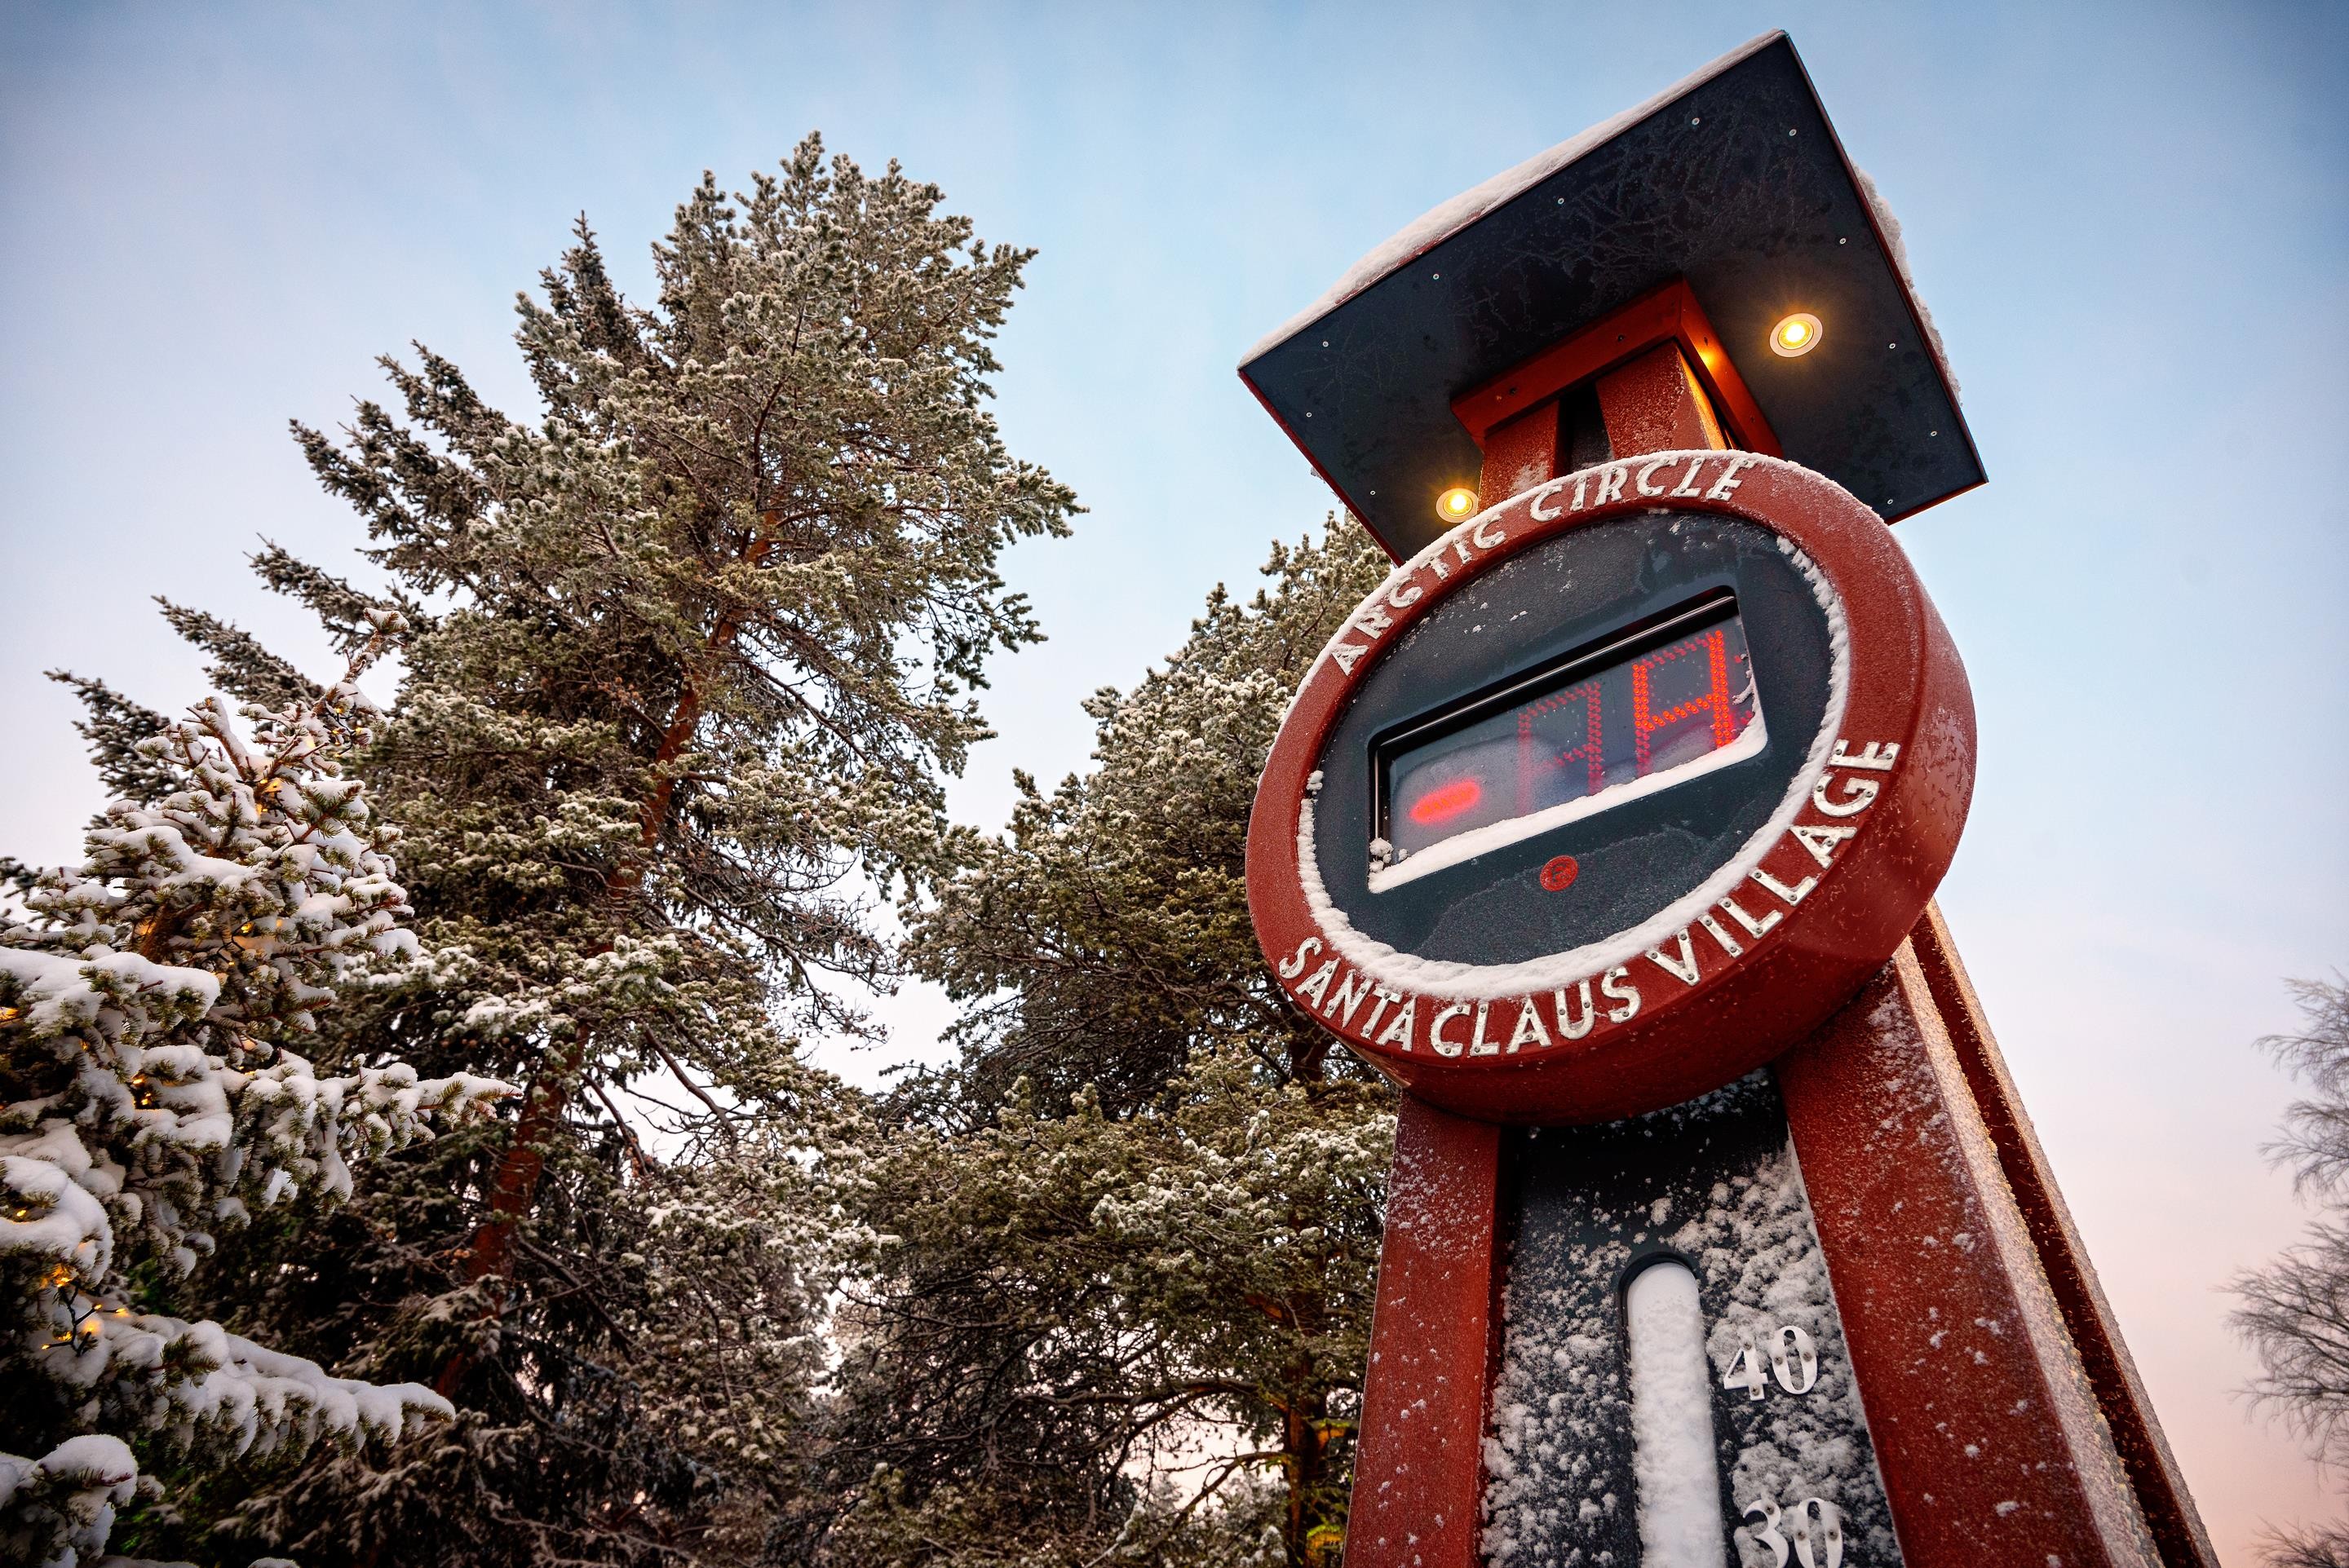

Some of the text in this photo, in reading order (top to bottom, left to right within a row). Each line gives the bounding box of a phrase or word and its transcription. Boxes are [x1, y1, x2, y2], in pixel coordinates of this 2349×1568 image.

[1329, 457, 1757, 676] ARCTIC CIRCLE
[1278, 739, 1901, 1058] SANTA CLAUS VILLAGE
[1723, 1325, 1818, 1401] 40
[1739, 1497, 1843, 1568] 30
